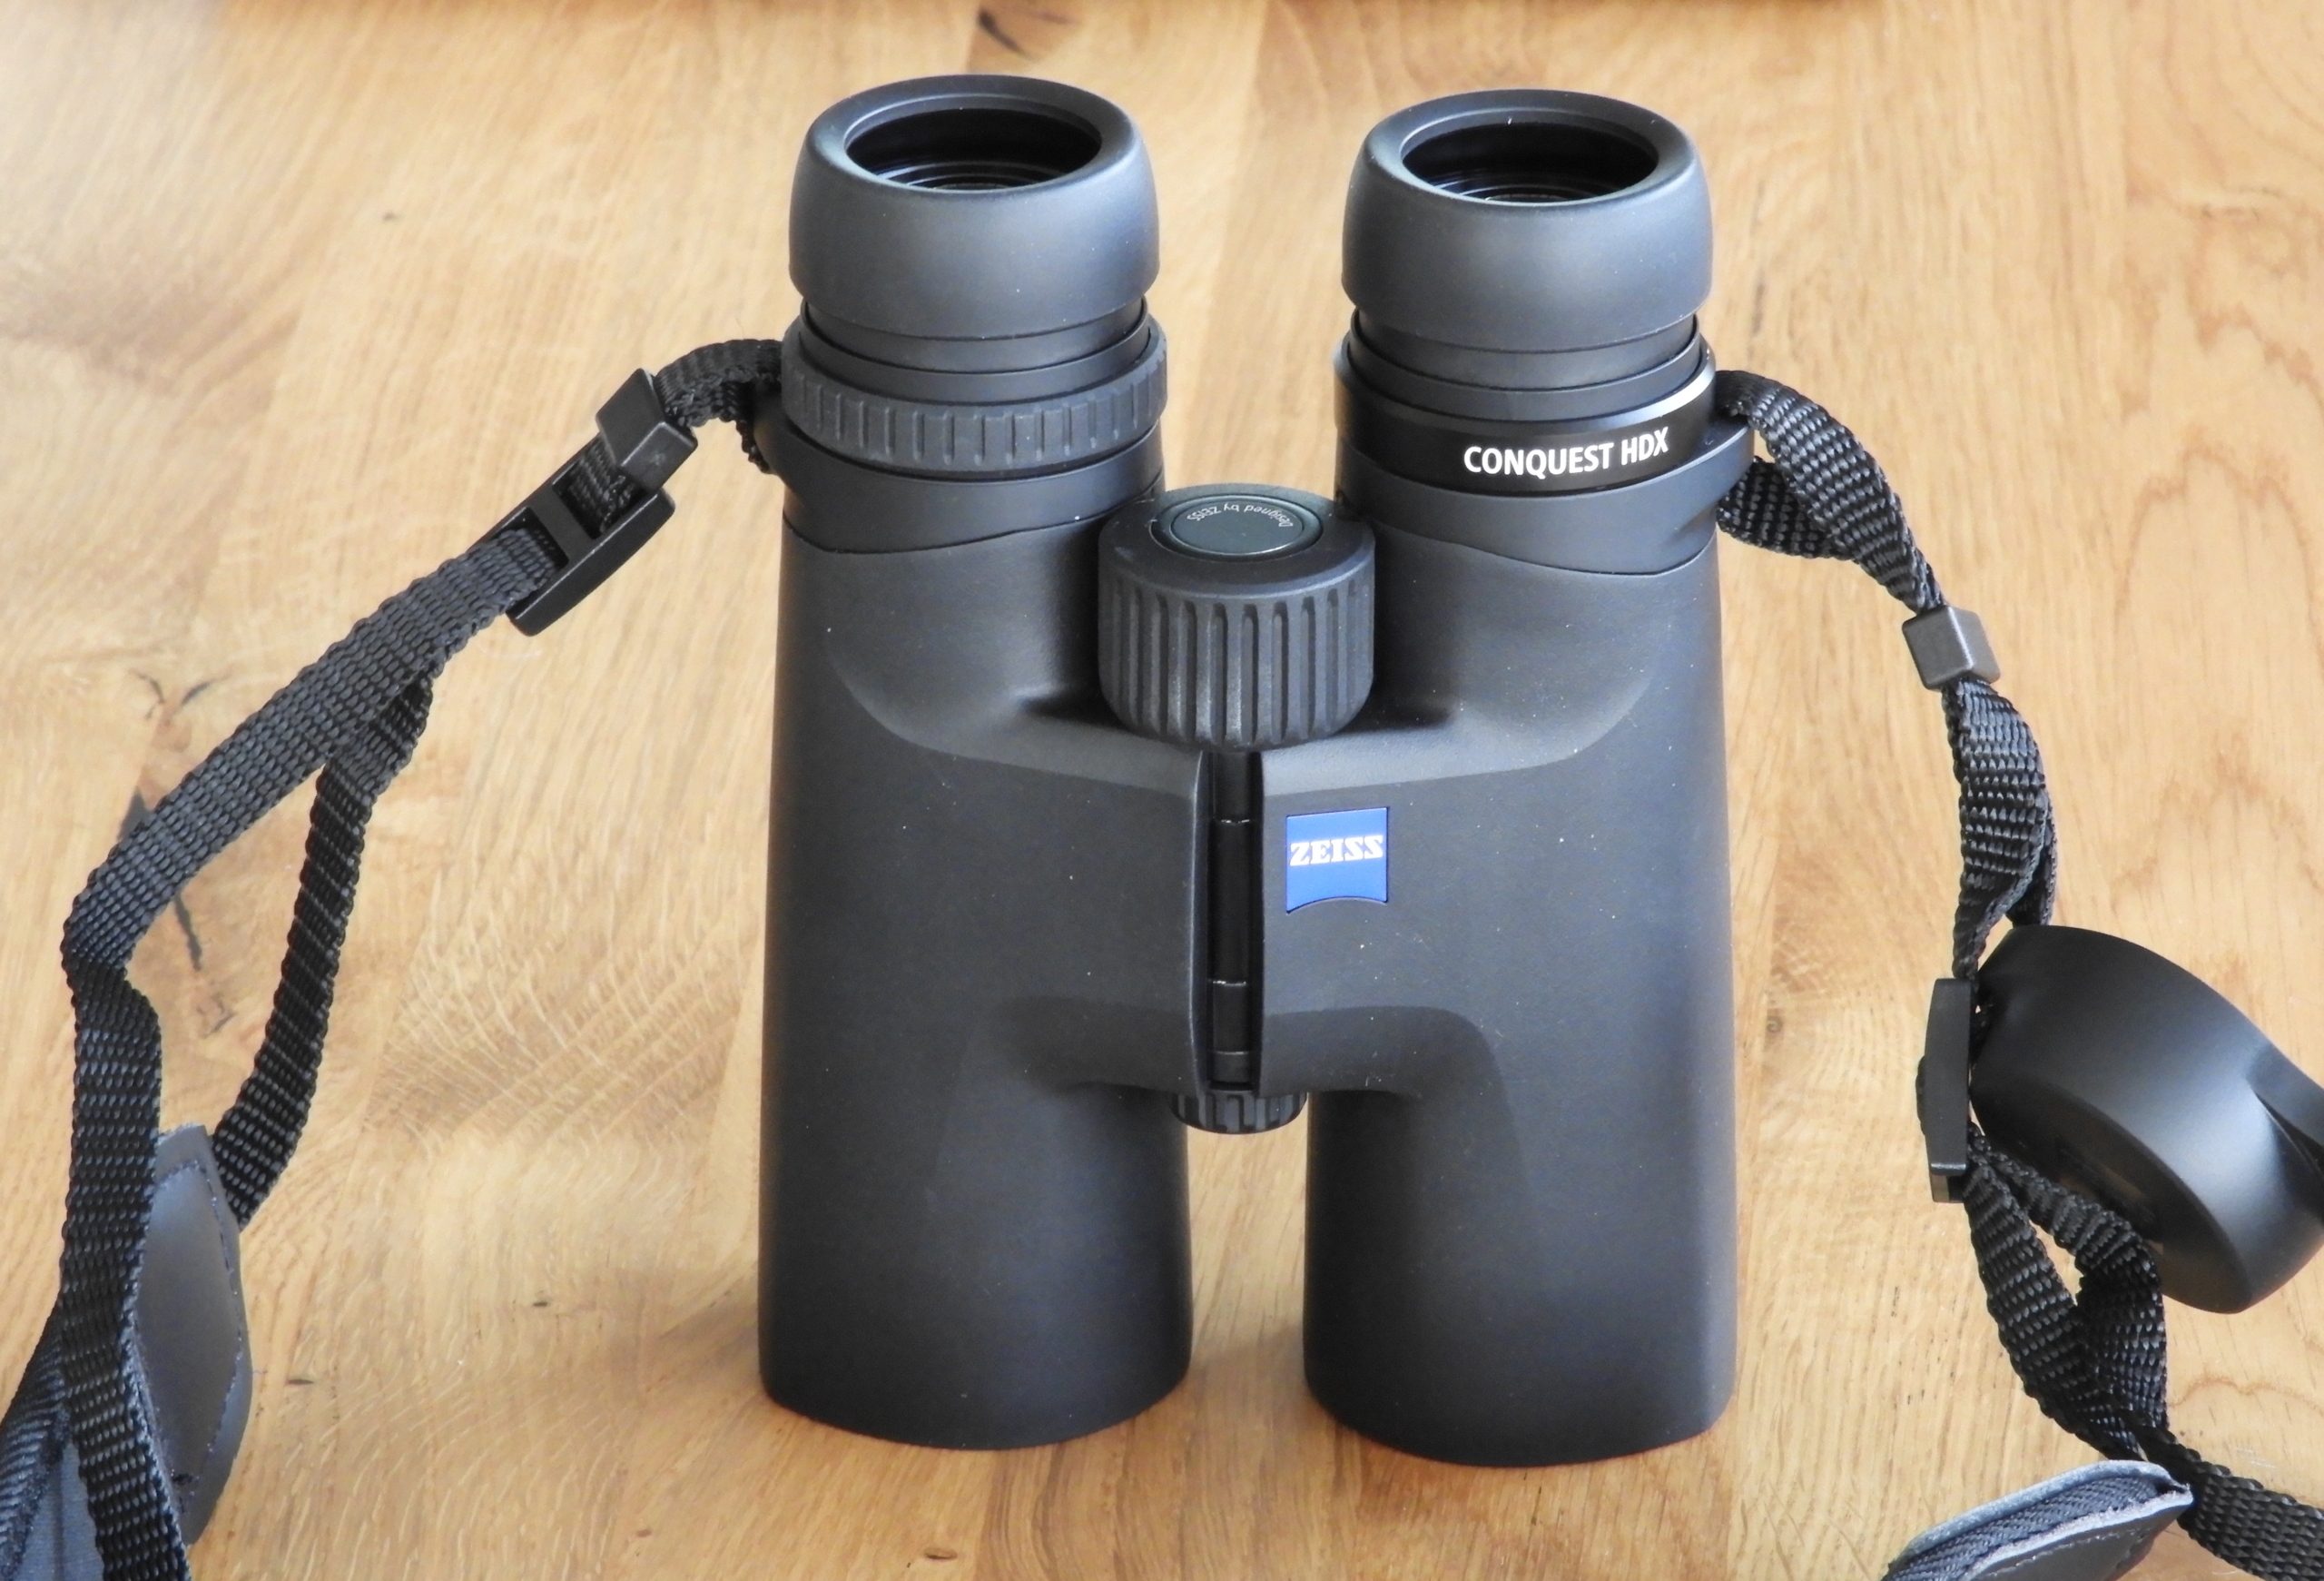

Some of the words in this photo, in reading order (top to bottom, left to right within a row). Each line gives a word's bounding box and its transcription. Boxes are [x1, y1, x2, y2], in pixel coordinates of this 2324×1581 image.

[1463, 442, 1614, 479] CONQUEST
[1620, 426, 1669, 465] HDX
[1187, 506, 1222, 521] ZEISS
[1224, 502, 1240, 512] by
[1244, 504, 1294, 528] Designed
[1289, 835, 1384, 866] ZEISS
